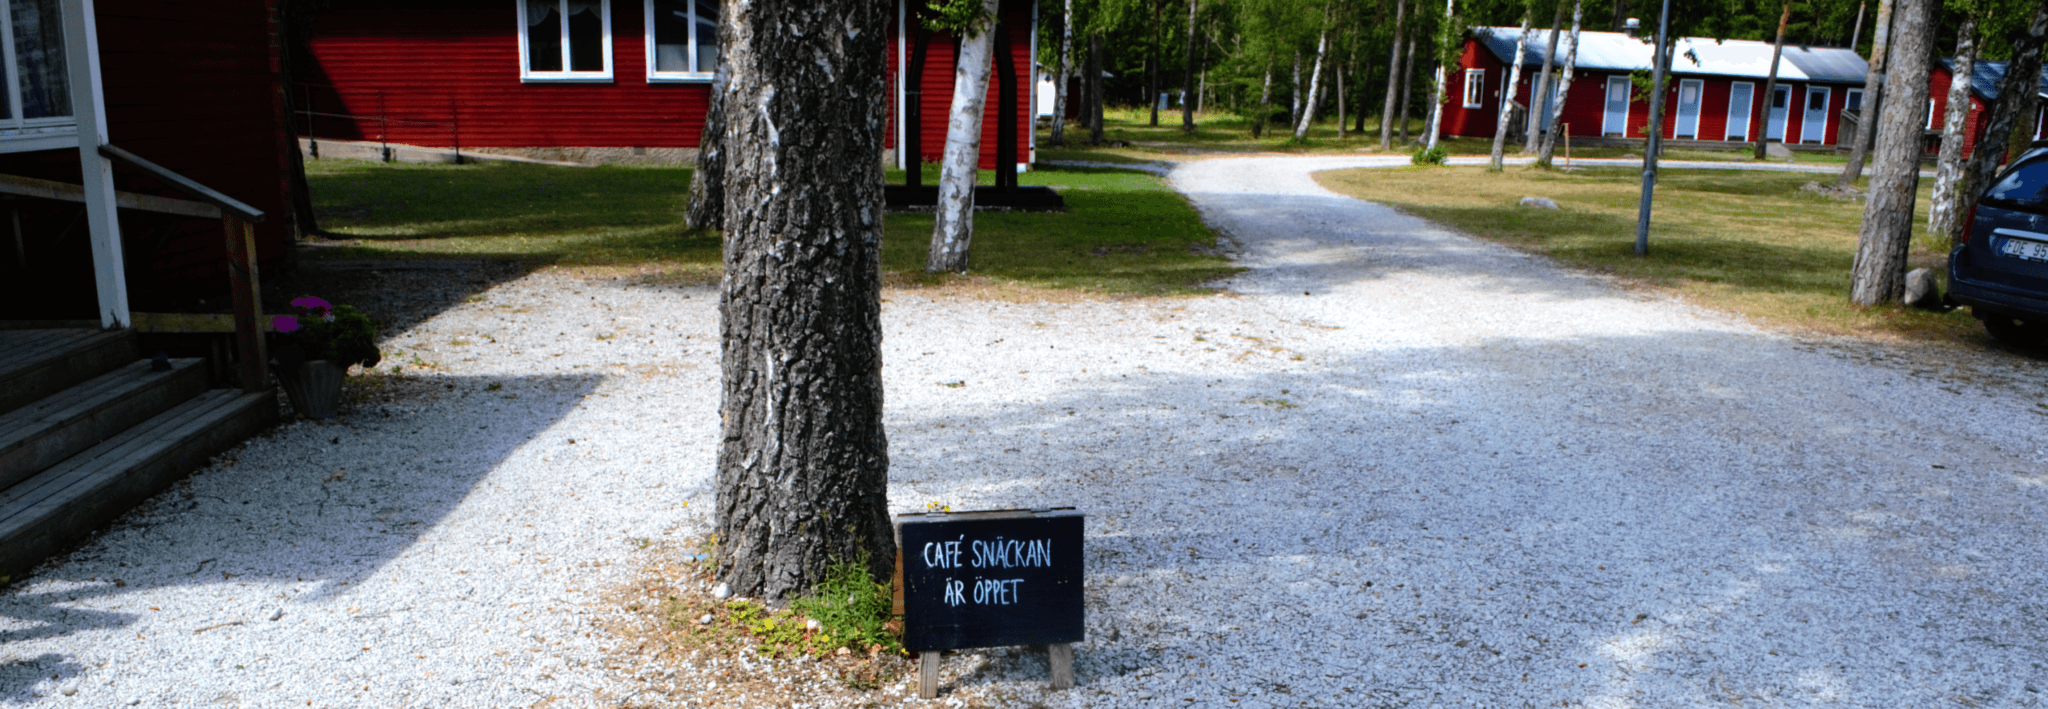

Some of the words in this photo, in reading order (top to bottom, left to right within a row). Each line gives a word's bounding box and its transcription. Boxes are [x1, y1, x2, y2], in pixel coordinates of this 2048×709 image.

[2033, 243, 2048, 258] 95
[923, 534, 964, 569] CAFÉ
[971, 536, 1051, 569] SNÄCKAN
[944, 577, 966, 607] ÄR
[973, 576, 1025, 605] ÖPPET
